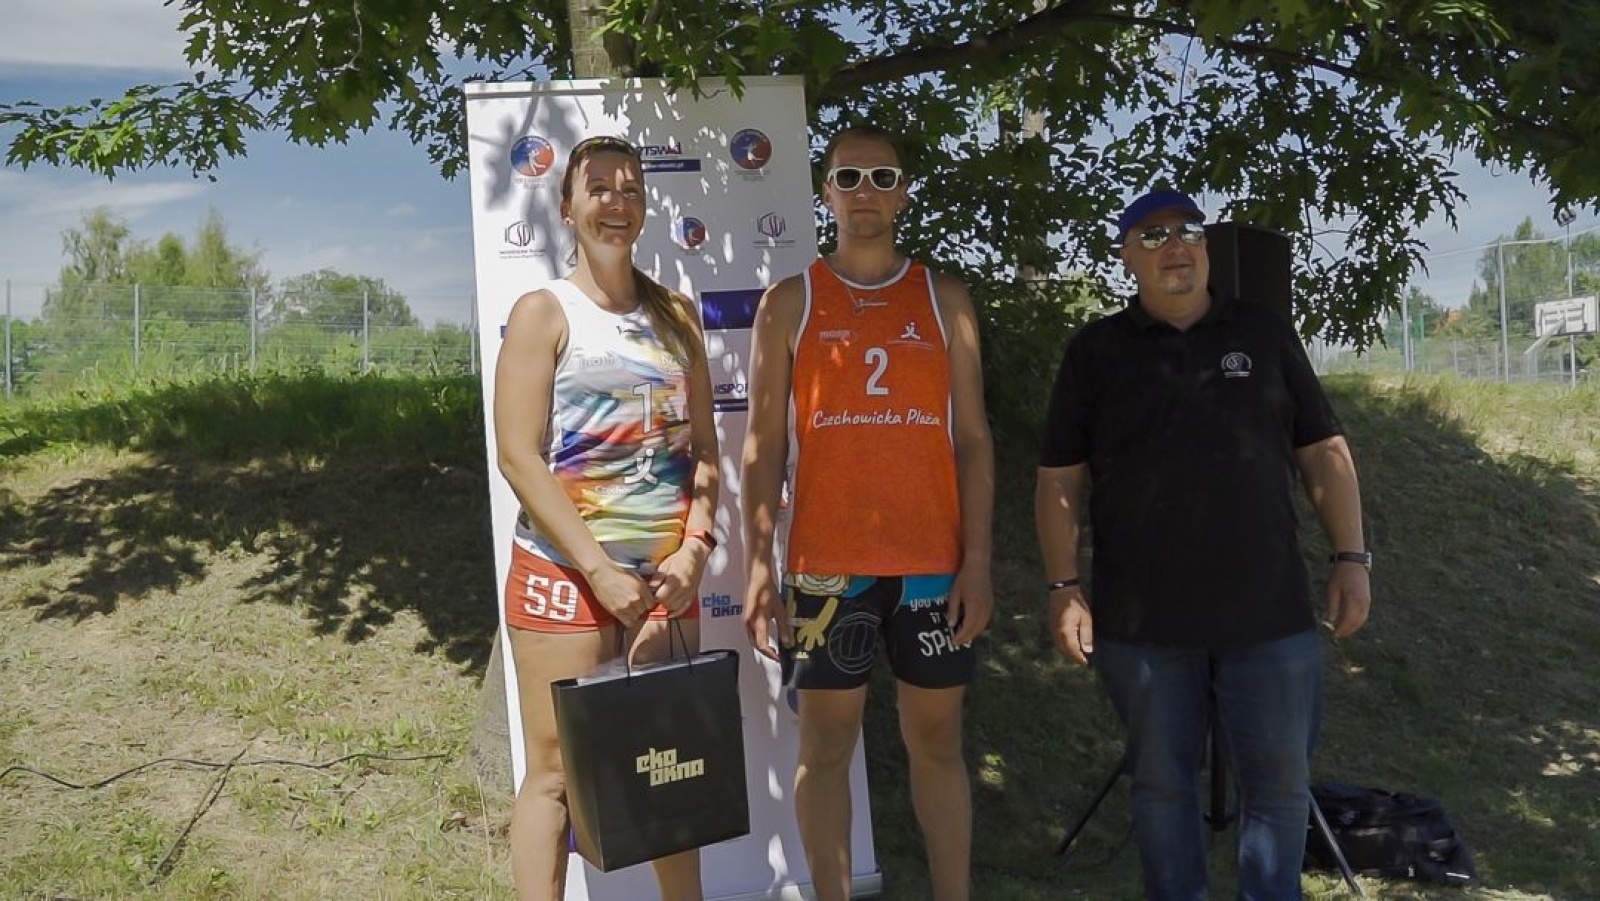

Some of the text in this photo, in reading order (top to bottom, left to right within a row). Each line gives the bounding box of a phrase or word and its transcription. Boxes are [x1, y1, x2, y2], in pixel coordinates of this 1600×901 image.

[864, 346, 889, 394] 2
[632, 381, 652, 434] 1
[813, 408, 903, 428] Czechowicka
[523, 574, 578, 621] 59
[636, 747, 677, 773] eko
[649, 758, 704, 786] okna
